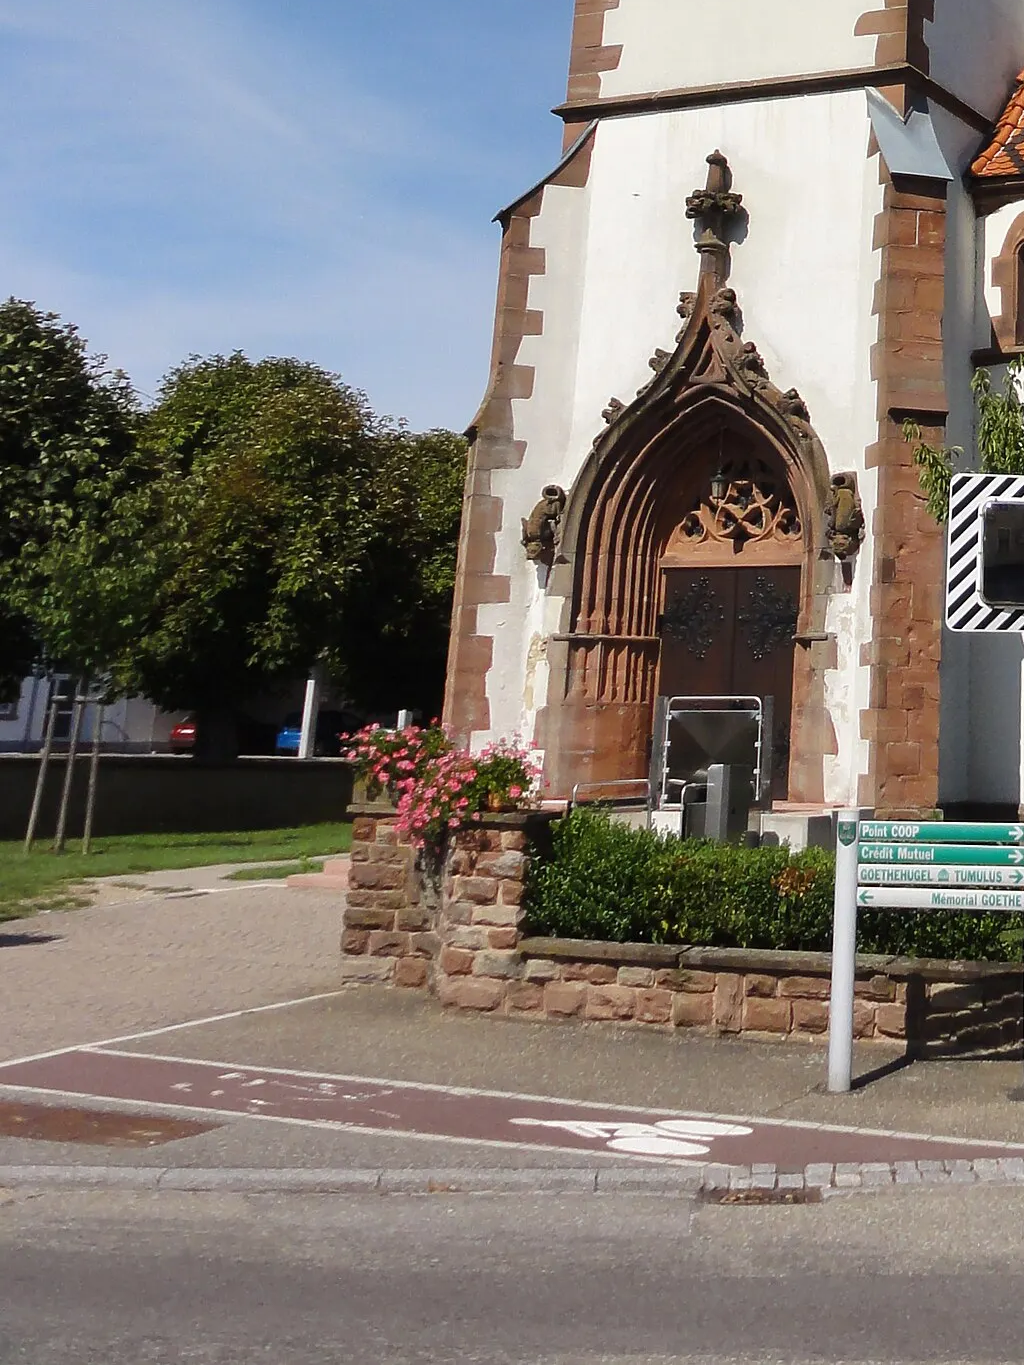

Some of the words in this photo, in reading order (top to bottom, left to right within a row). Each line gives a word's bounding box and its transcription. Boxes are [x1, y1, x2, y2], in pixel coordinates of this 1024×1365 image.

[862, 825, 887, 837] Point
[891, 825, 919, 838] COOP
[861, 846, 893, 859] Crédit
[898, 847, 935, 861] Mutuel
[954, 869, 1003, 883] TUMULUS
[931, 892, 977, 906] Mémorial
[981, 894, 1022, 907] GOETHE
